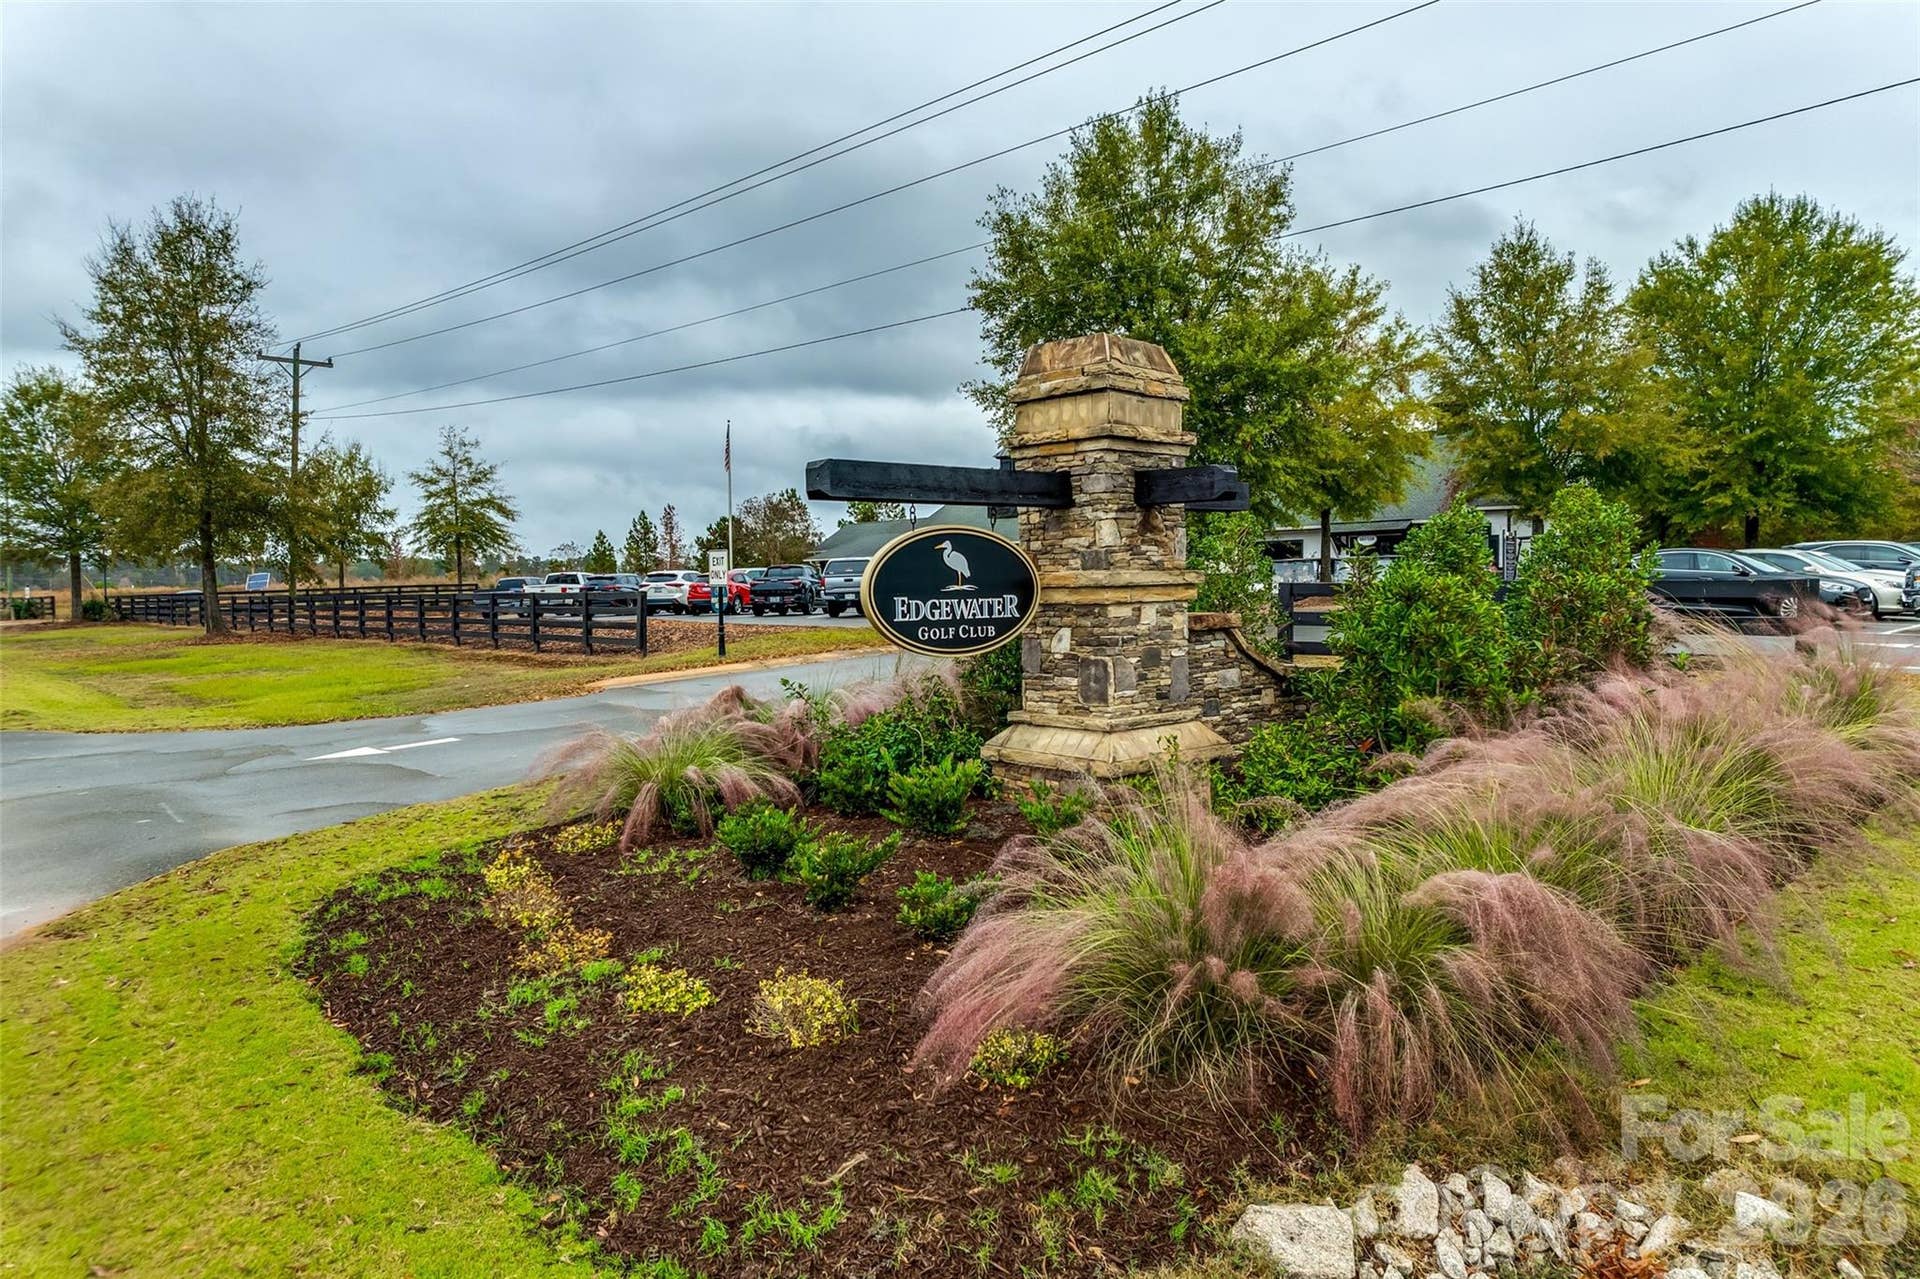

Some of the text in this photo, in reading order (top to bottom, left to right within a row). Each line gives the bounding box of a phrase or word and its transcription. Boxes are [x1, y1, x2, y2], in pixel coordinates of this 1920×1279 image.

[712, 556, 725, 566] EXIT
[711, 569, 726, 580] ONLY
[893, 594, 1020, 622] EDGEWATER
[918, 625, 996, 640] GOLF CLUB
